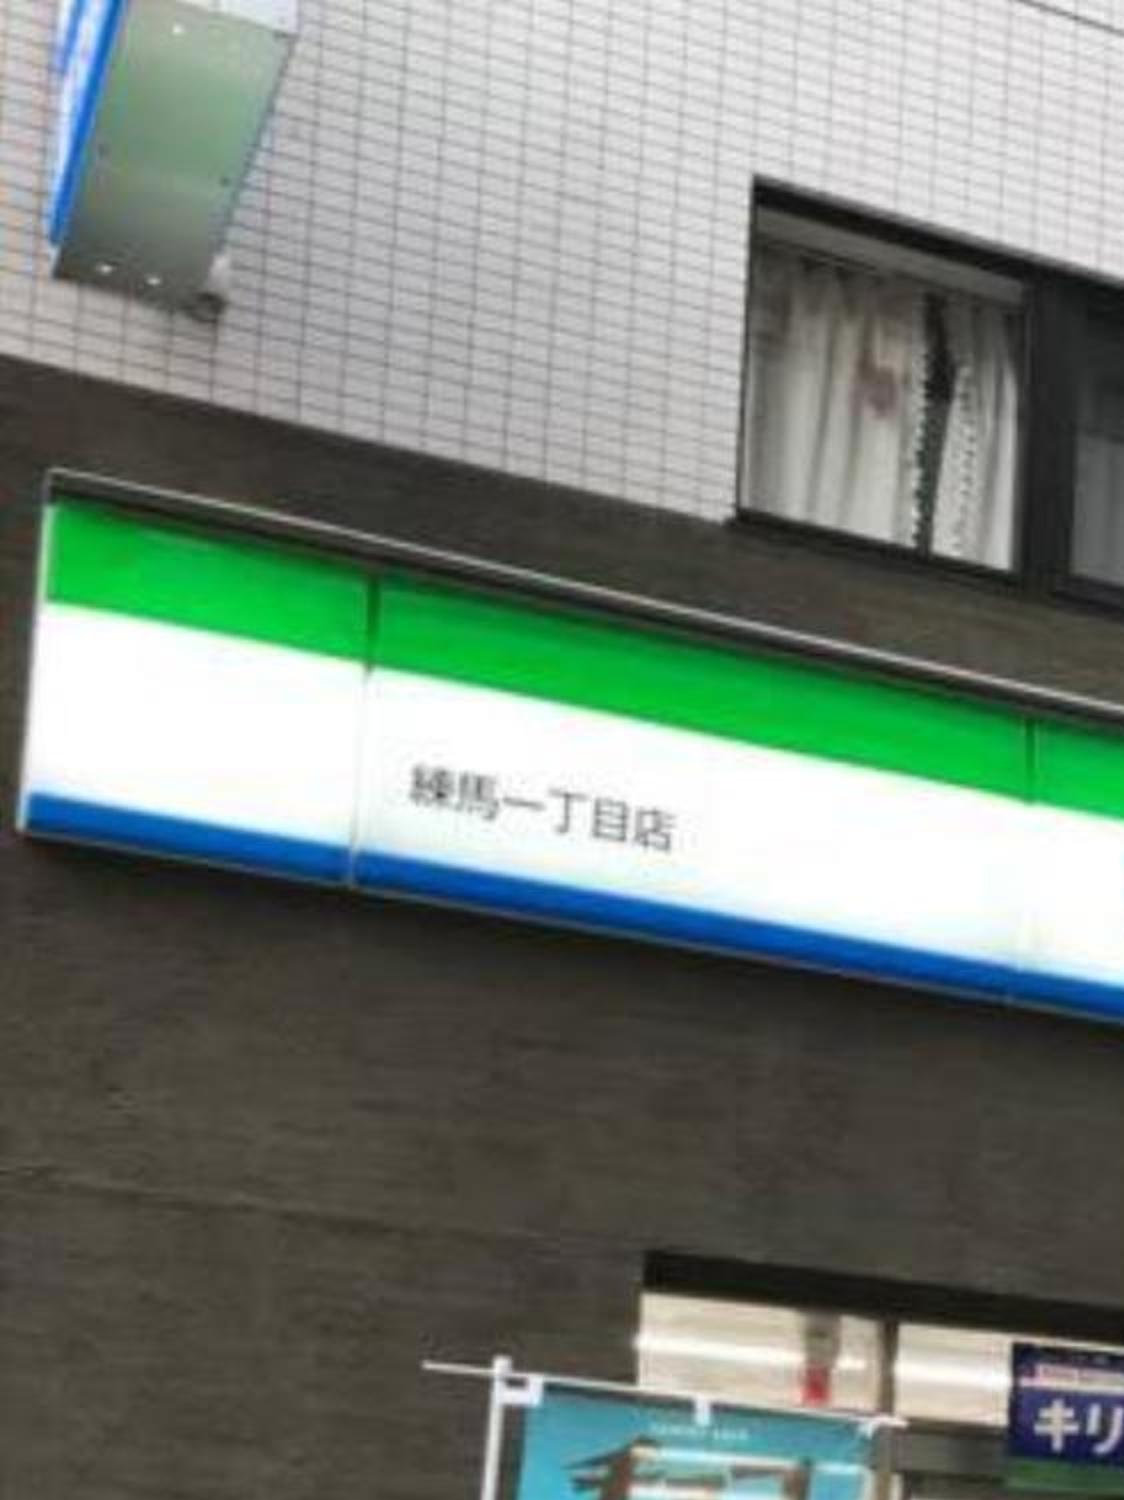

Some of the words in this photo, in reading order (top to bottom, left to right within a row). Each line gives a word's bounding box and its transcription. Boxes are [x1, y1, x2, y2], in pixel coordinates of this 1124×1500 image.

[410, 766, 676, 852] 練馬一丁目店
